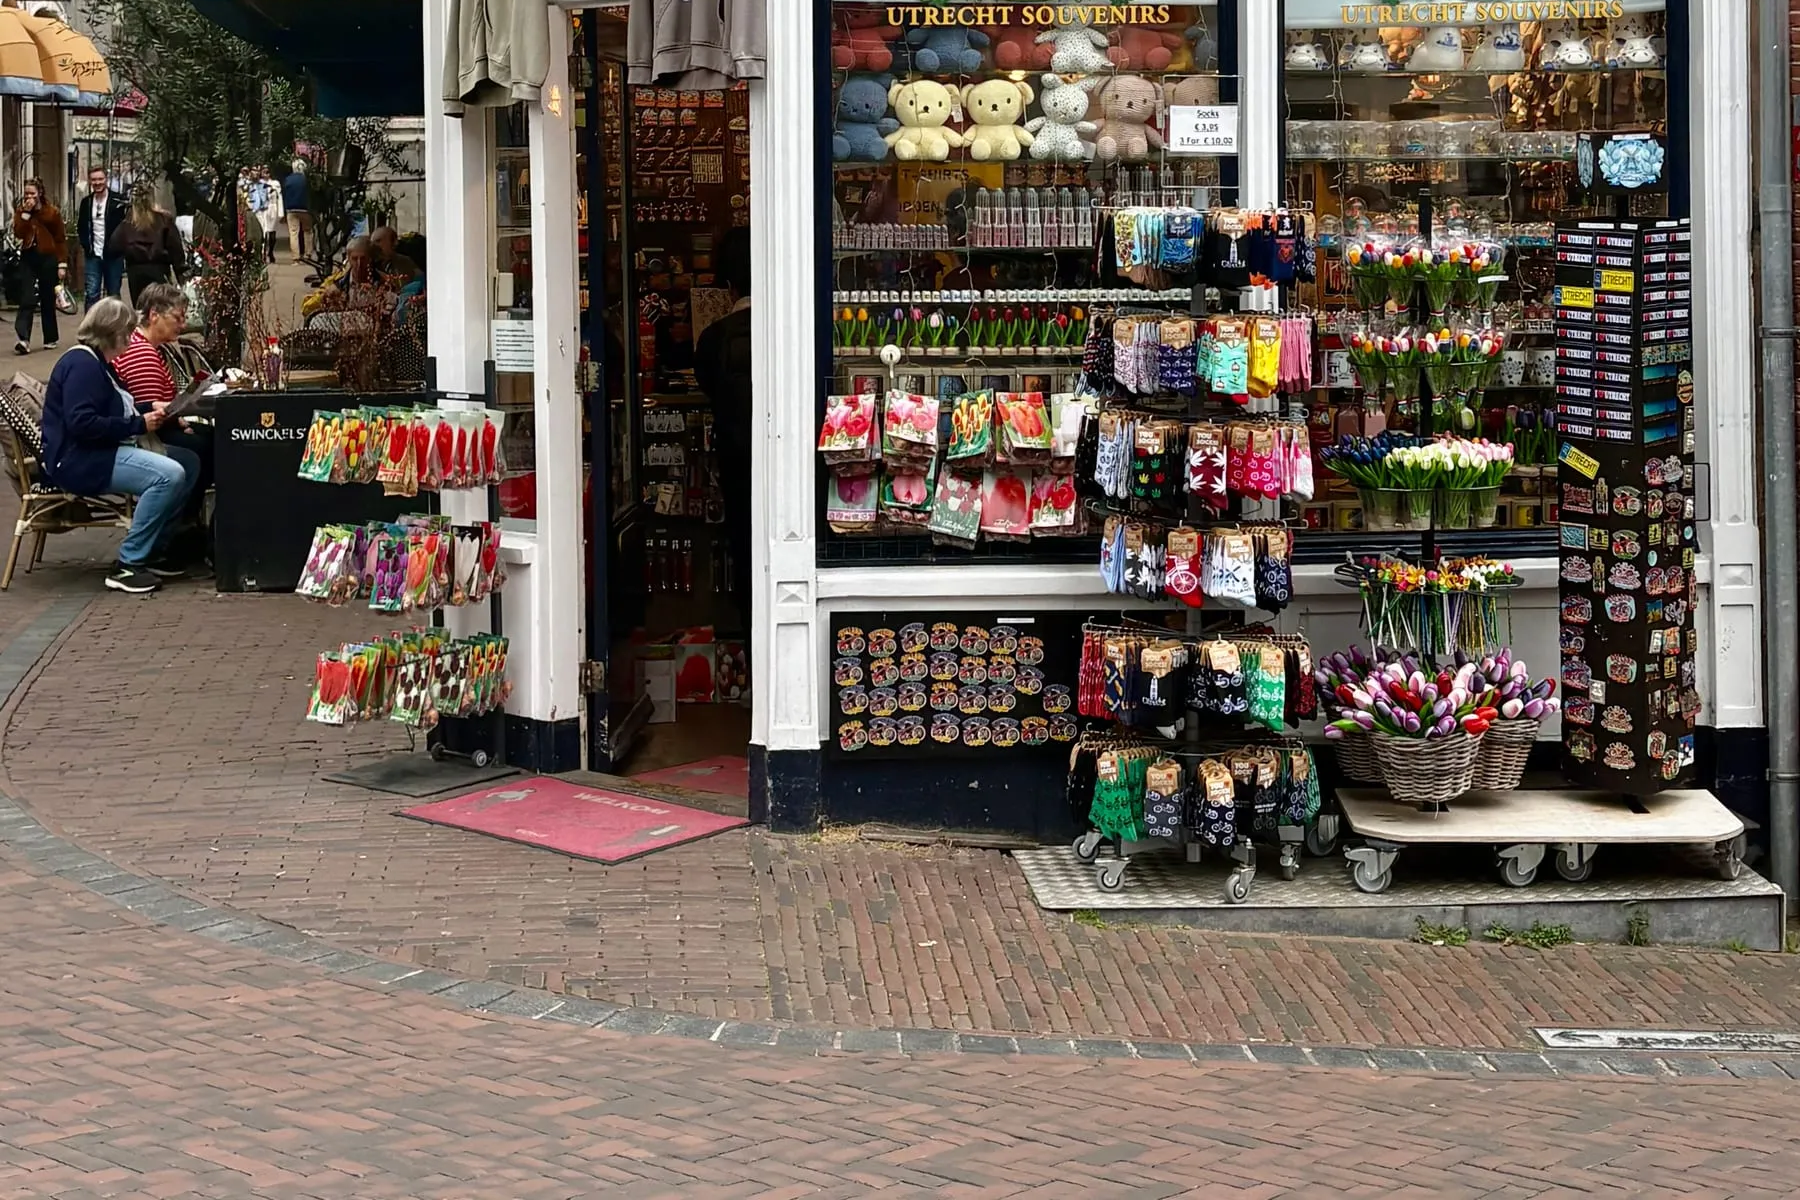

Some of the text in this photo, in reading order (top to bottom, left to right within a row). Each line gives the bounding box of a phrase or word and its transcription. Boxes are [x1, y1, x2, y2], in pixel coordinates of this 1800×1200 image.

[886, 4, 1170, 27] UTRECHT SOUVENIRS
[1341, 0, 1623, 24] UTRECHT SOUVENIRS
[1603, 275, 1633, 287] UTRECHT
[1563, 290, 1592, 302] UTRECHT
[231, 427, 306, 441] SWINCKELS'
[1568, 450, 1598, 472] UTRECHT
